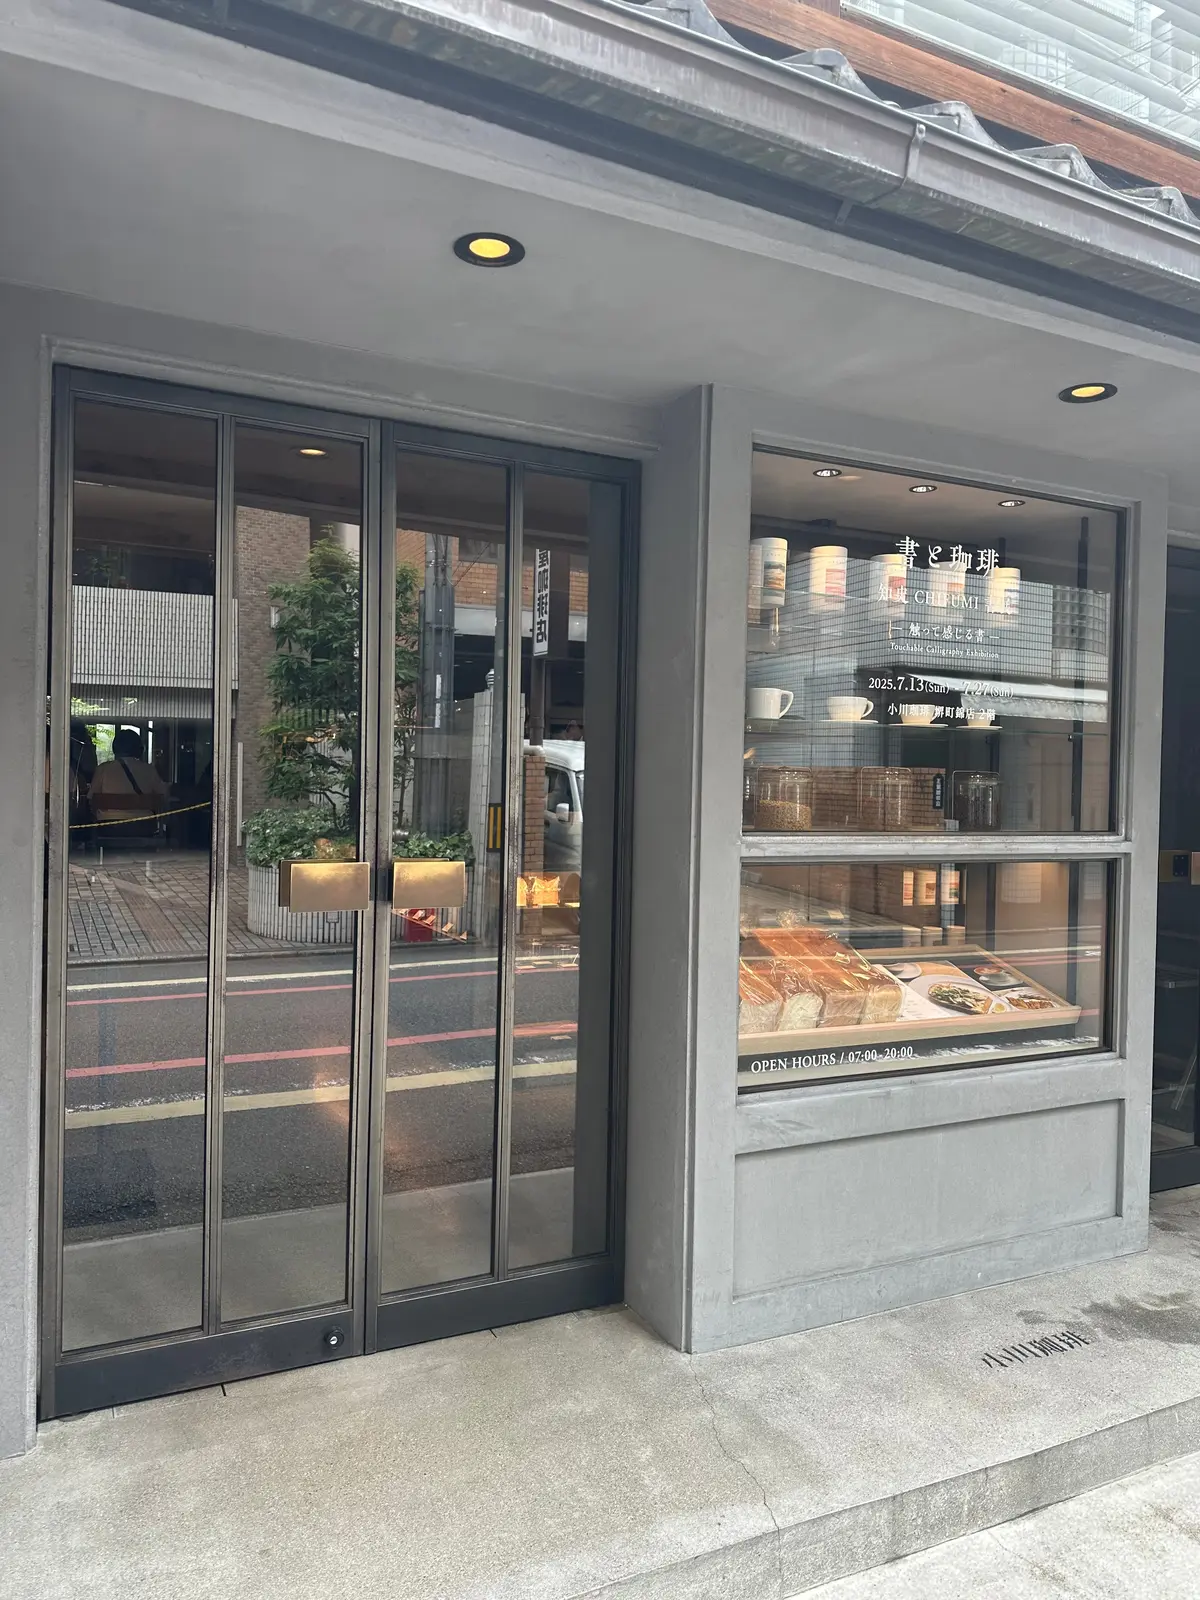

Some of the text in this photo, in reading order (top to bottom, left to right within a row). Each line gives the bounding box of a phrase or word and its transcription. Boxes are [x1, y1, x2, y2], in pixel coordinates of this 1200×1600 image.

[895, 535, 1000, 578] 書と珈琲
[908, 622, 986, 643] 触って感じる書
[890, 642, 999, 659] Touchable Calligraphy Exhibition
[868, 676, 950, 695] 2025.7.13(Sun)
[751, 1057, 788, 1074] OPEN
[792, 1052, 836, 1069] HOURS
[848, 1046, 913, 1063] 07:00-20:00
